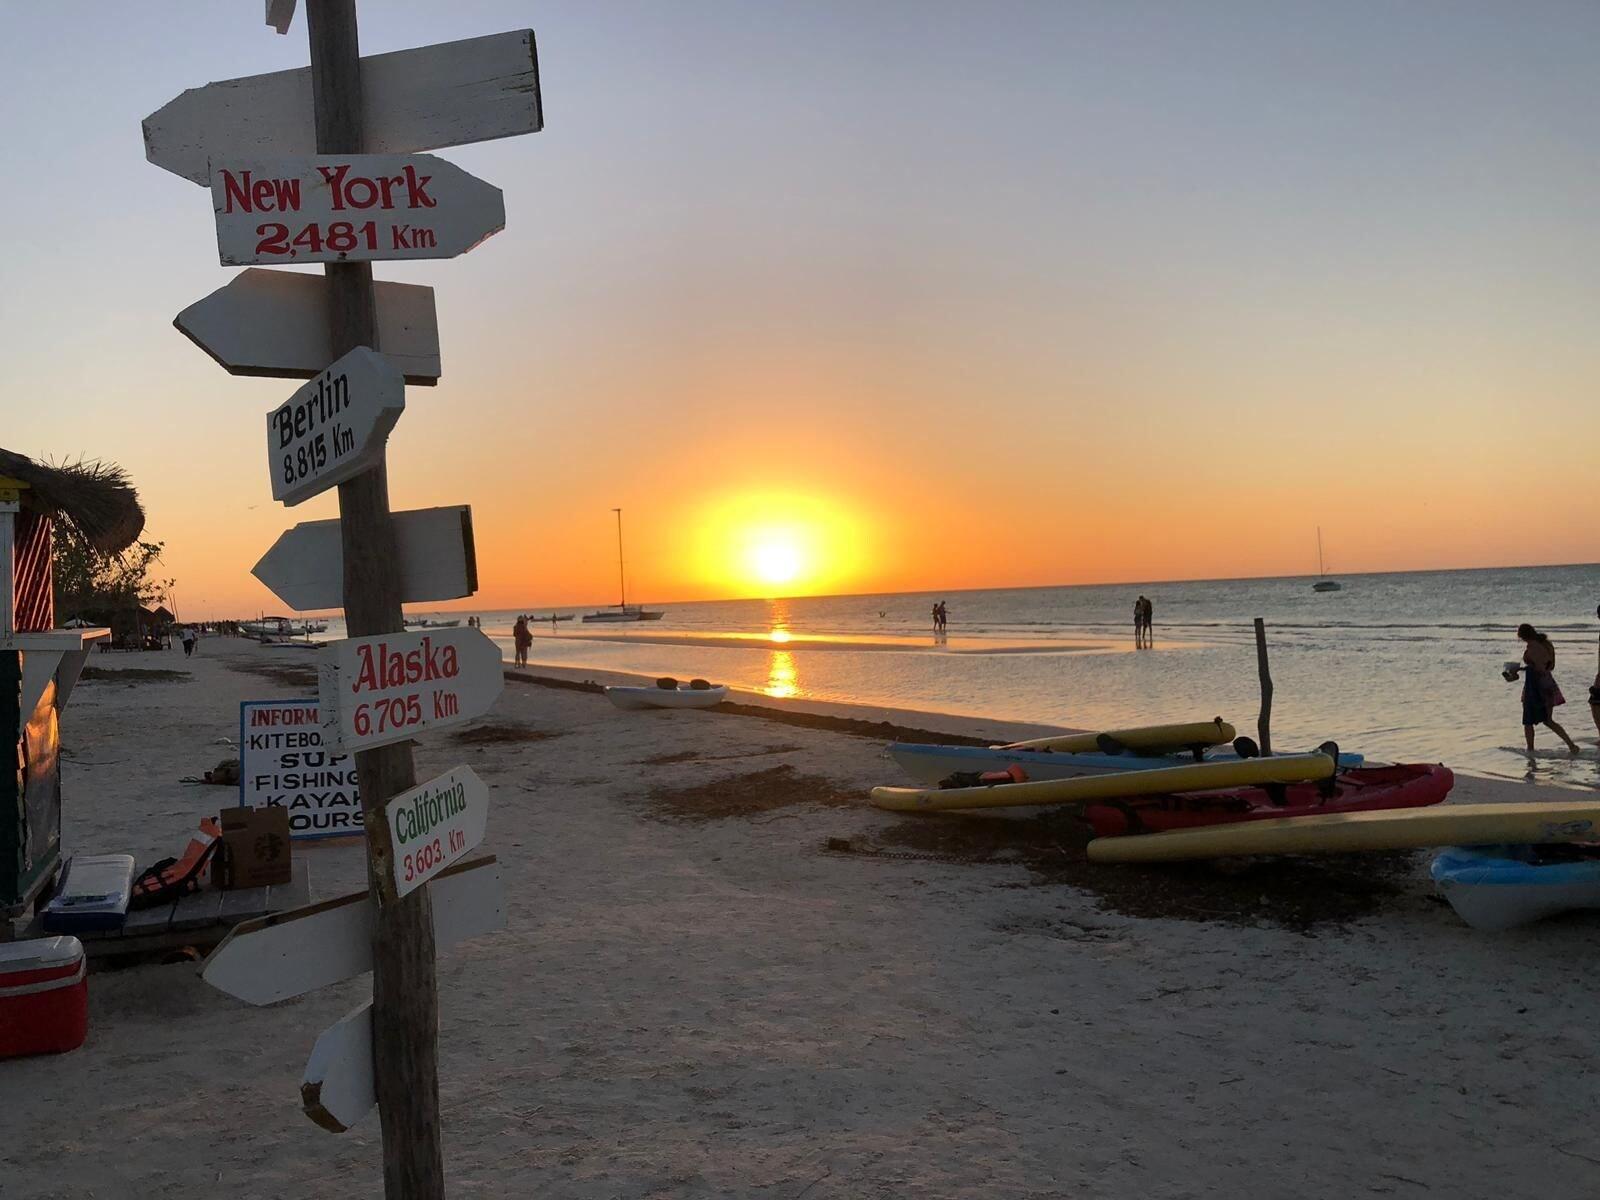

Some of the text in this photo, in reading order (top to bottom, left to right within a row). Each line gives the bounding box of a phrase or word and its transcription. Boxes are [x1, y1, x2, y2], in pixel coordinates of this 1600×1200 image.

[218, 164, 437, 214] New York
[255, 220, 437, 258] 2,481 Km
[273, 371, 351, 449] Berlin
[333, 423, 355, 459] Km
[352, 636, 460, 693] Alaska
[433, 689, 459, 719] Km
[250, 732, 324, 750] KITEBO
[255, 770, 360, 791] FISHING
[395, 775, 467, 844] California
[448, 829, 465, 853] Km
